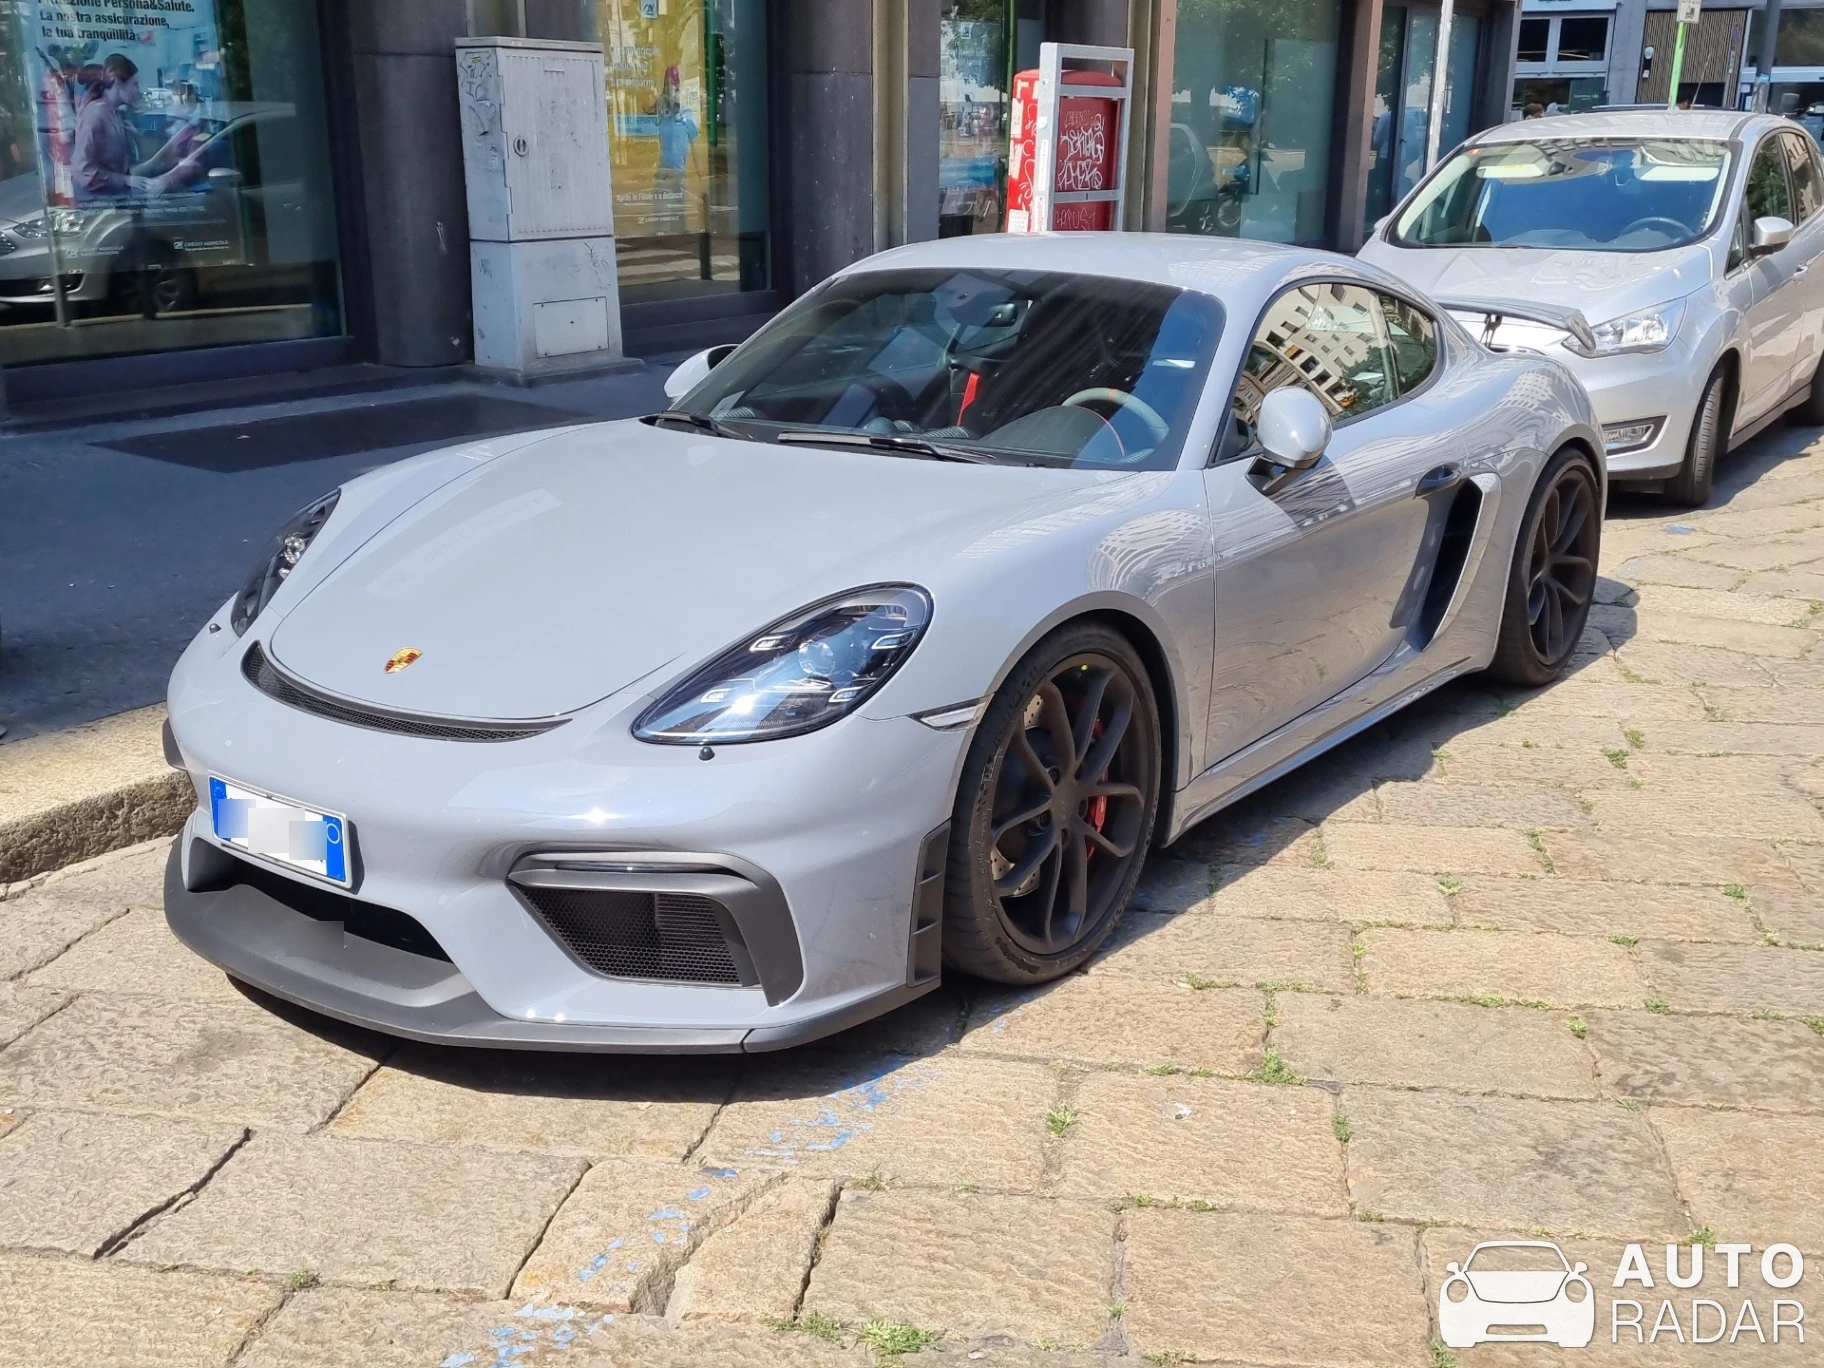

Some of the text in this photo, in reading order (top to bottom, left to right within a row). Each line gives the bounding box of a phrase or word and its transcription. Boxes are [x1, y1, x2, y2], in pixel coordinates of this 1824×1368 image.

[40, 10, 170, 28] La nostra assicurazione,
[55, 26, 74, 38] tua
